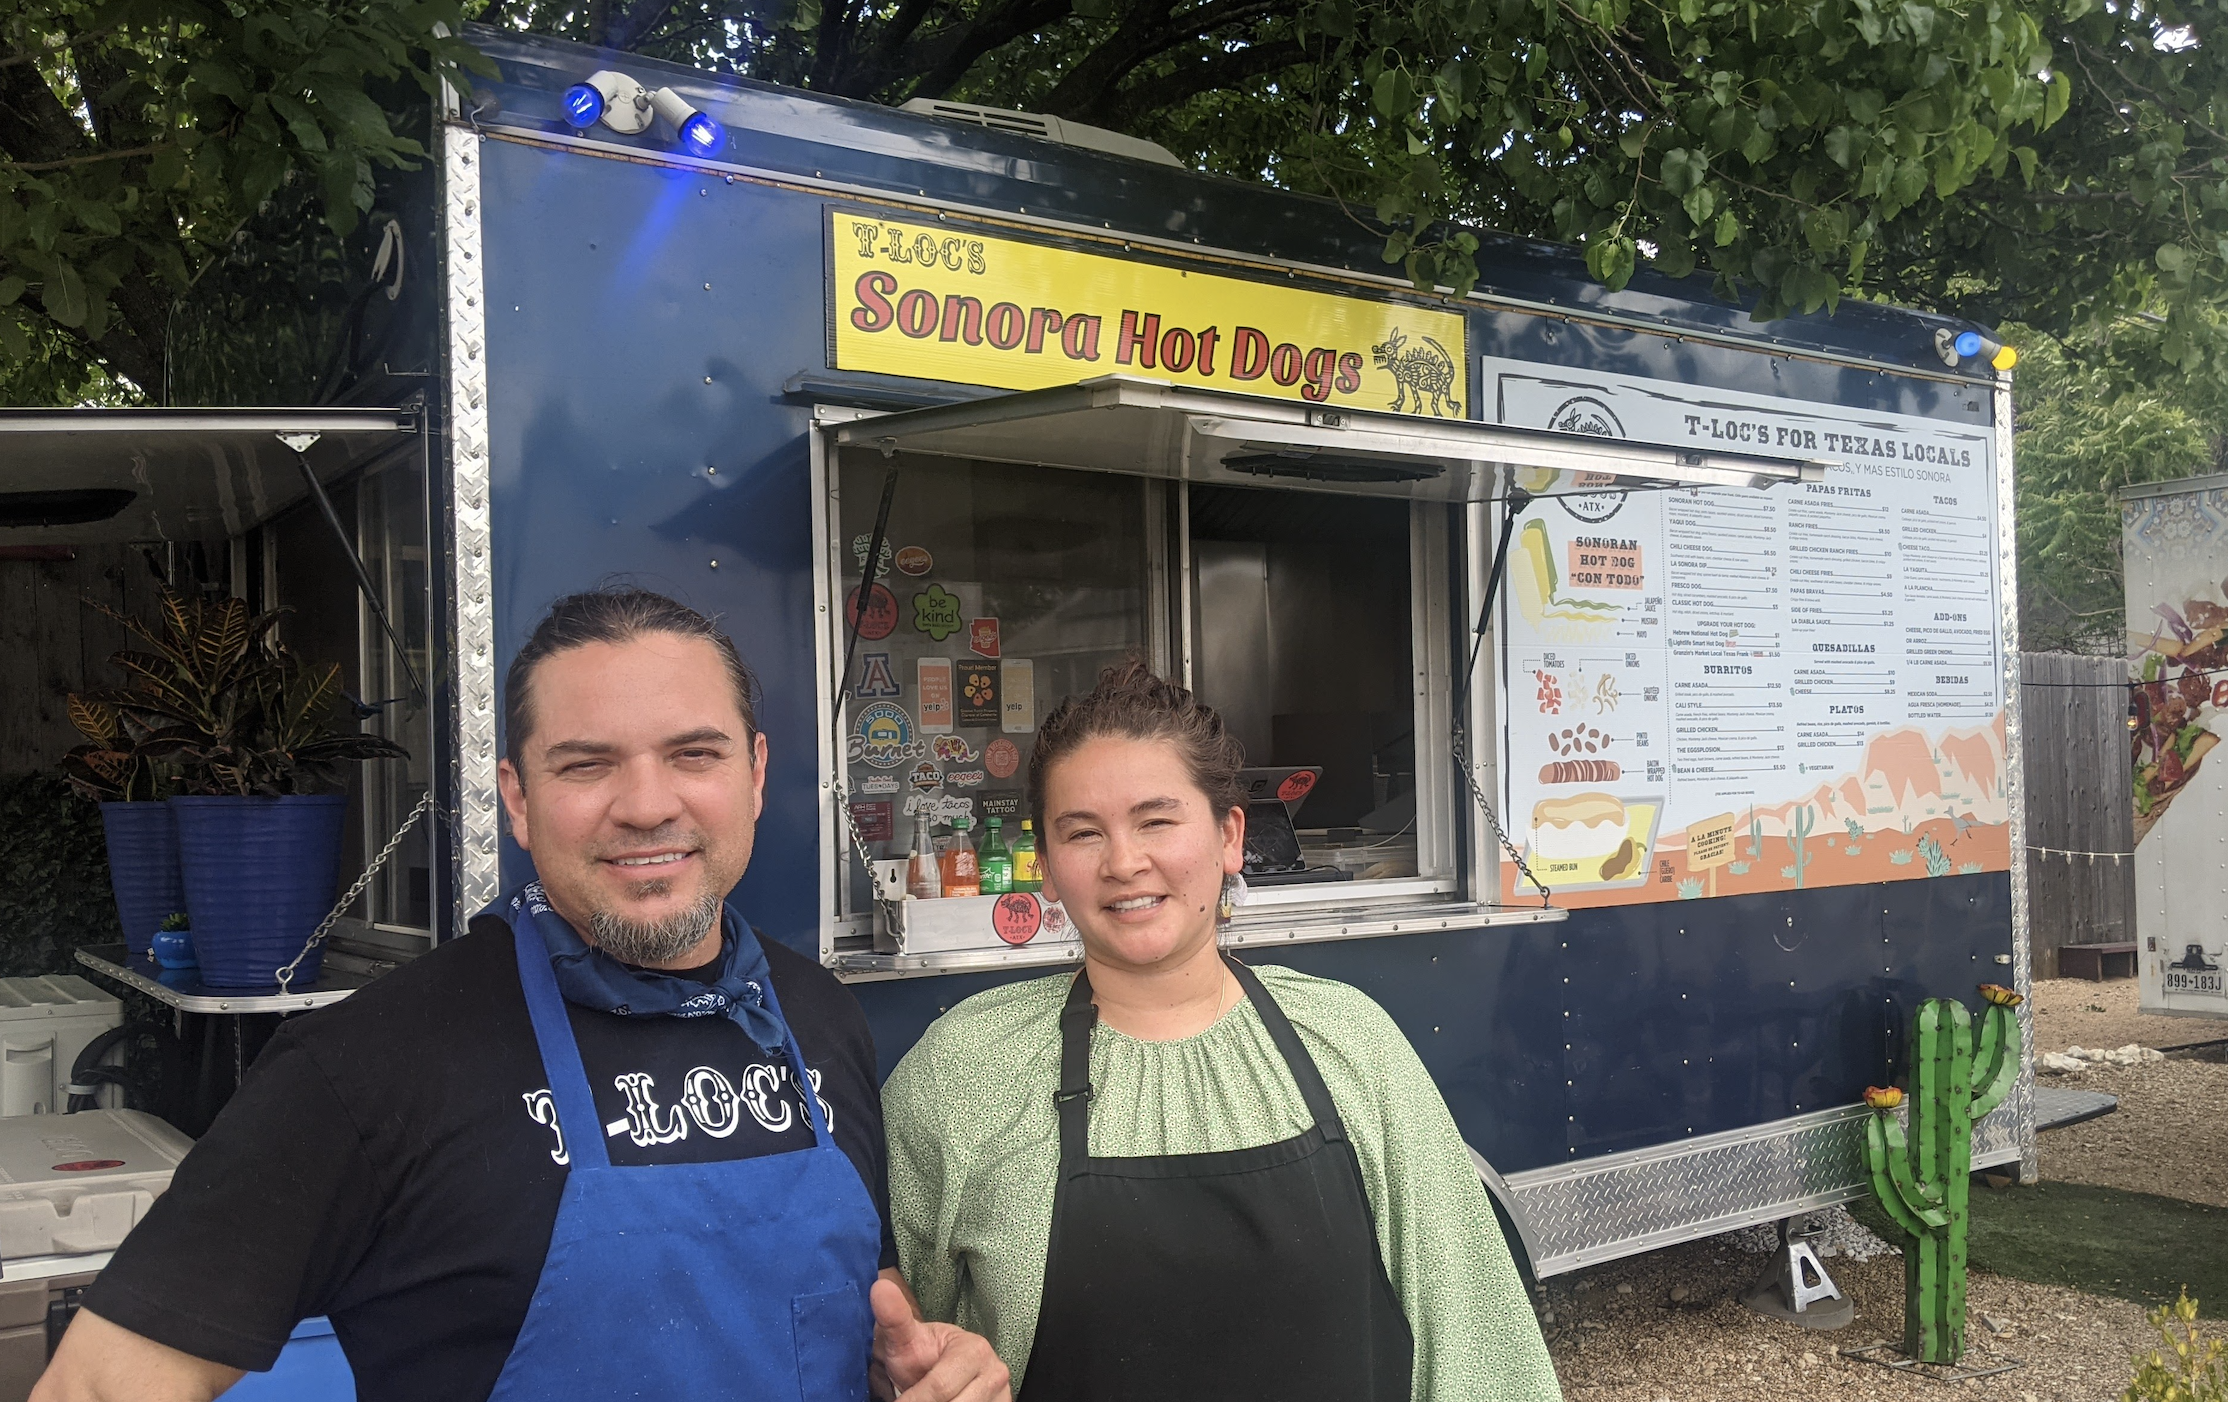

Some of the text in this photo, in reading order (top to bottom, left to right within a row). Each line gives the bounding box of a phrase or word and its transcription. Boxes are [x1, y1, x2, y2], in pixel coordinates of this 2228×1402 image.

[852, 222, 986, 275] T-LOC'S
[850, 270, 1363, 402] Sonora Hot Dogs
[1685, 415, 1971, 468] T-LOC'S FOR TEXAS LOCALS
[1855, 464, 1951, 483] Y MAS ESTILO SONORA
[1806, 484, 1871, 497] PAPAS FRITAS
[1933, 496, 1957, 505] TACOS
[1583, 502, 1600, 512] ATX
[1576, 537, 1637, 550] SONORAN
[1580, 555, 1635, 568] HOT DOG
[930, 595, 947, 608] be
[922, 609, 953, 622] kind
[1934, 613, 1967, 622] ADD-ONS
[1812, 644, 1875, 652] QUESADILLAS
[1543, 660, 1564, 668] TOMATOES
[1704, 666, 1752, 674] BURRITOS
[856, 653, 899, 698] A
[1936, 676, 1969, 684] BEBIDAS
[924, 703, 940, 712] yelp
[1006, 703, 1022, 711] yelp
[1830, 706, 1864, 714] PLATOS
[866, 711, 903, 725] 5000
[847, 736, 926, 758] Burnet
[913, 772, 940, 781] TACO
[906, 798, 969, 812] i love tacos
[983, 799, 1018, 807] MAINSTAY
[1707, 826, 1732, 838] MINUTE
[1697, 835, 1726, 847] COOKING!
[1550, 863, 1578, 872] STEAMED BUN
